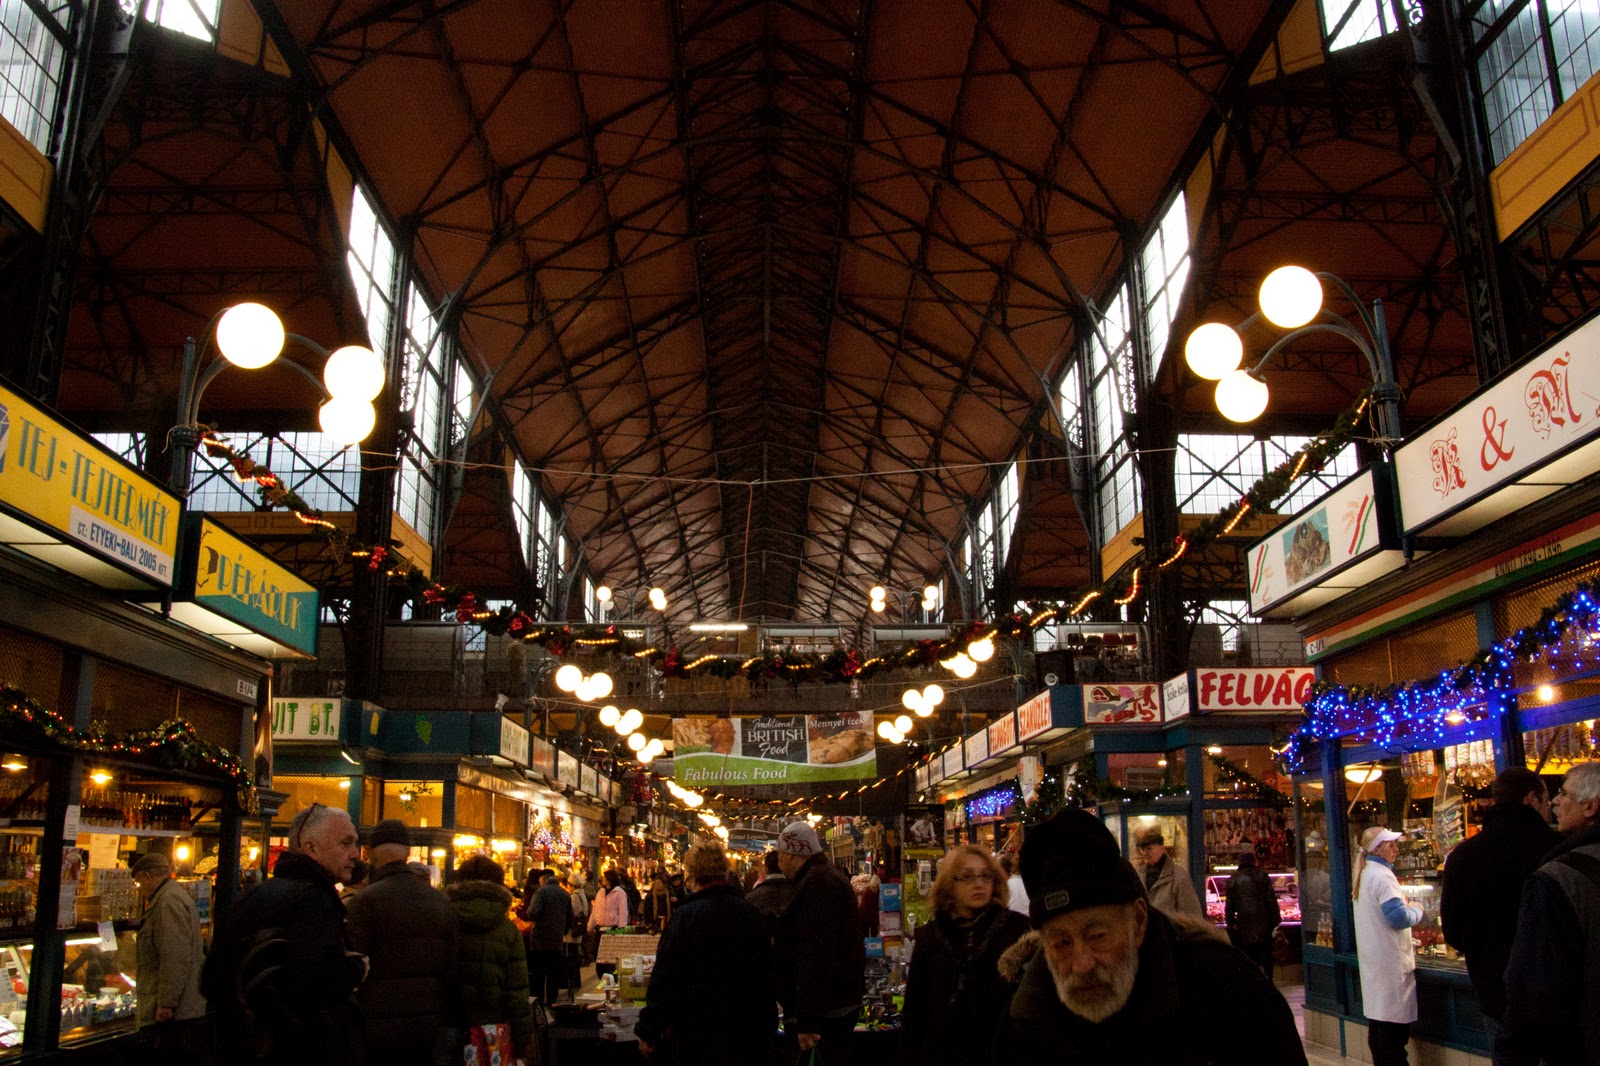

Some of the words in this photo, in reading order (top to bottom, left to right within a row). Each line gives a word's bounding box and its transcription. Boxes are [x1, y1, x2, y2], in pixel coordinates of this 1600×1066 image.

[1480, 406, 1515, 472] &
[90, 522, 138, 562] ETYEKI-BALI
[138, 547, 157, 571] 2005
[303, 702, 335, 736] BT.
[752, 717, 796, 730] Traditional
[808, 717, 845, 731] Mennyei
[747, 728, 804, 743] BRITISH
[759, 741, 789, 758] Food
[684, 767, 748, 781] Fabulous
[752, 766, 787, 780] Food
